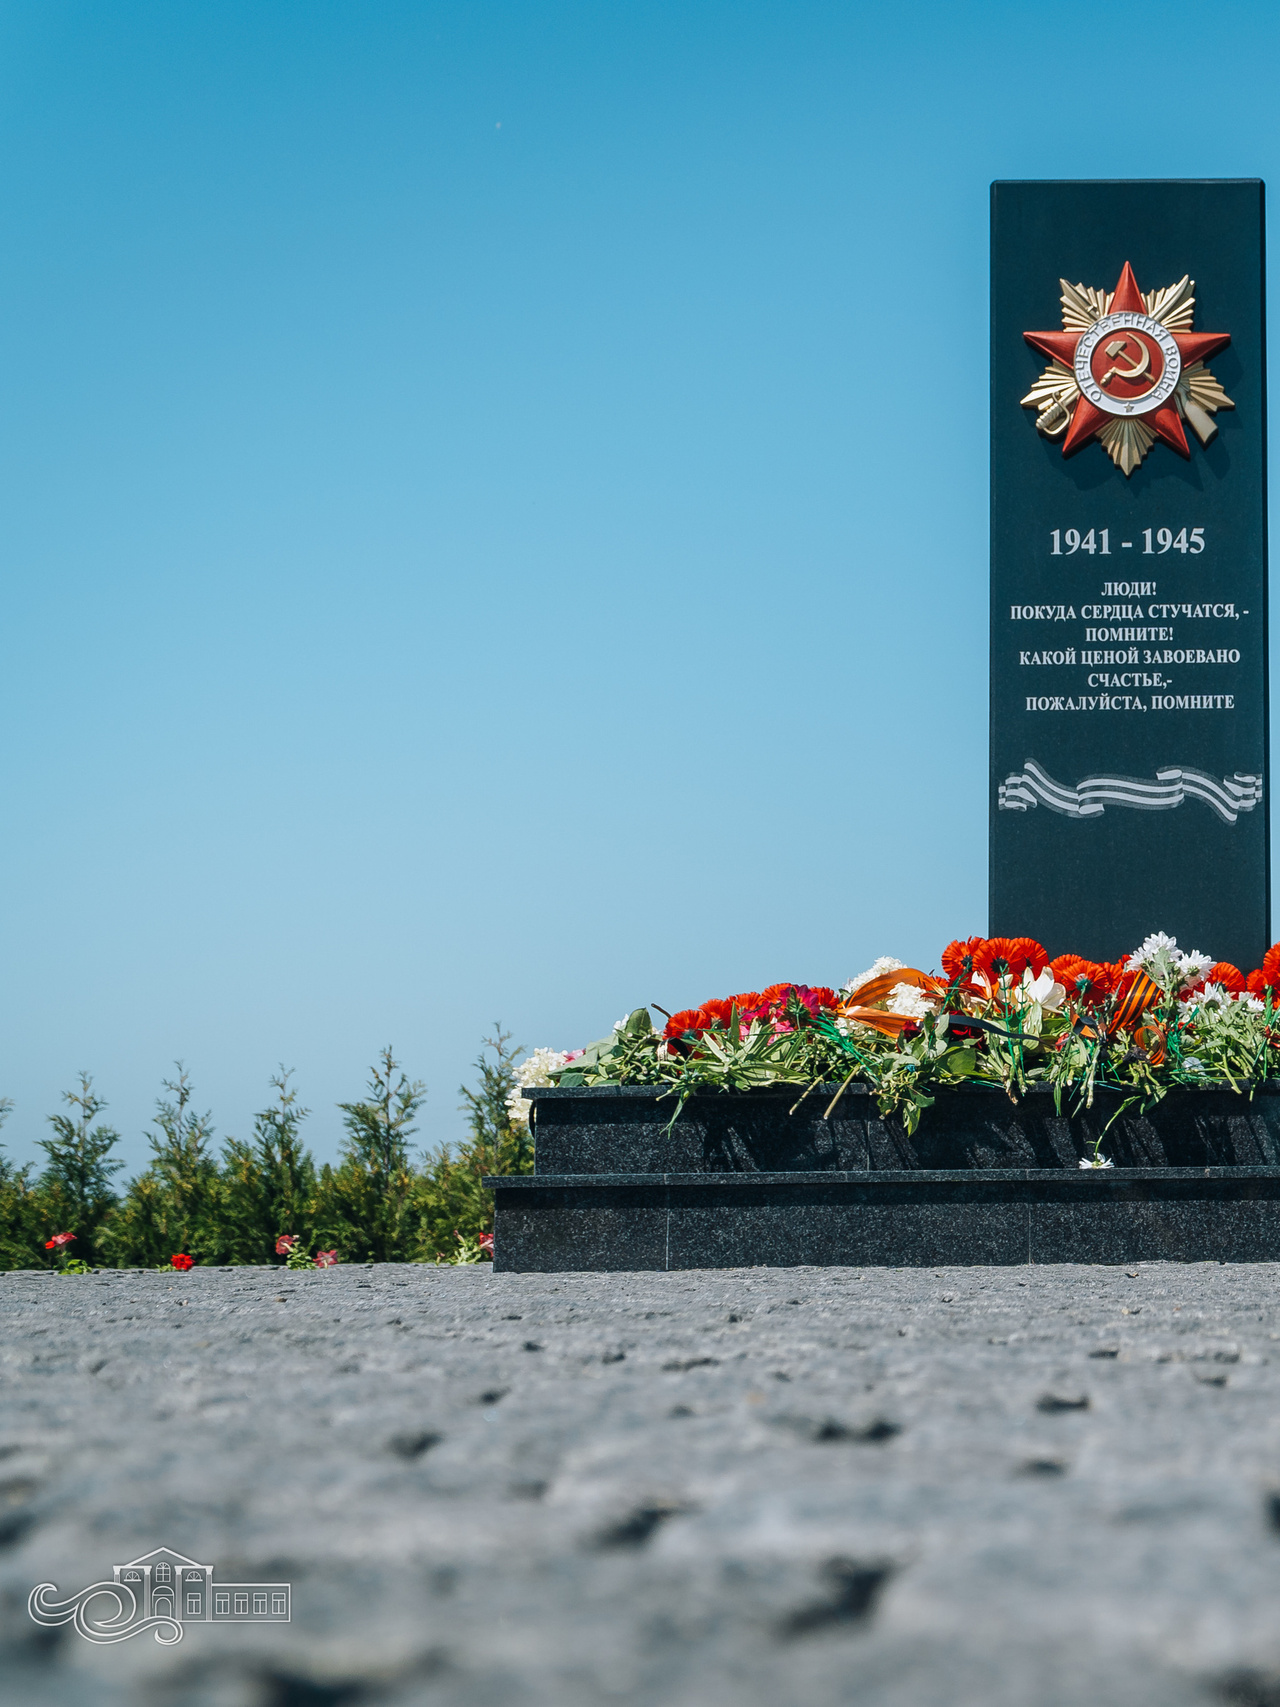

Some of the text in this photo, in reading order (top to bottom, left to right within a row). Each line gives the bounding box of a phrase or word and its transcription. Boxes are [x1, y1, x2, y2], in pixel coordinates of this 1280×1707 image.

[1075, 313, 1170, 402] ОТЕЧЕСТВЕННАЯ
[1050, 528, 1112, 555] 1941
[1141, 527, 1206, 555] 1945
[1101, 582, 1157, 597] ЛЮДИ!
[1010, 605, 1077, 622] ПОКУДА
[1080, 604, 1144, 621] СЕРДЦА
[1148, 603, 1240, 620] СТУЧАТСЯ,
[1085, 627, 1174, 642] ПОМНИТЕ!
[1019, 647, 1241, 667] КАКОЙ ЦЕНОЙ ЗАВОЕВАНО
[1087, 672, 1173, 689] СЧАСТЬЕ,-
[1025, 693, 1235, 712] ПОЖАЛУЙСТА, ПОМНИТЕ
